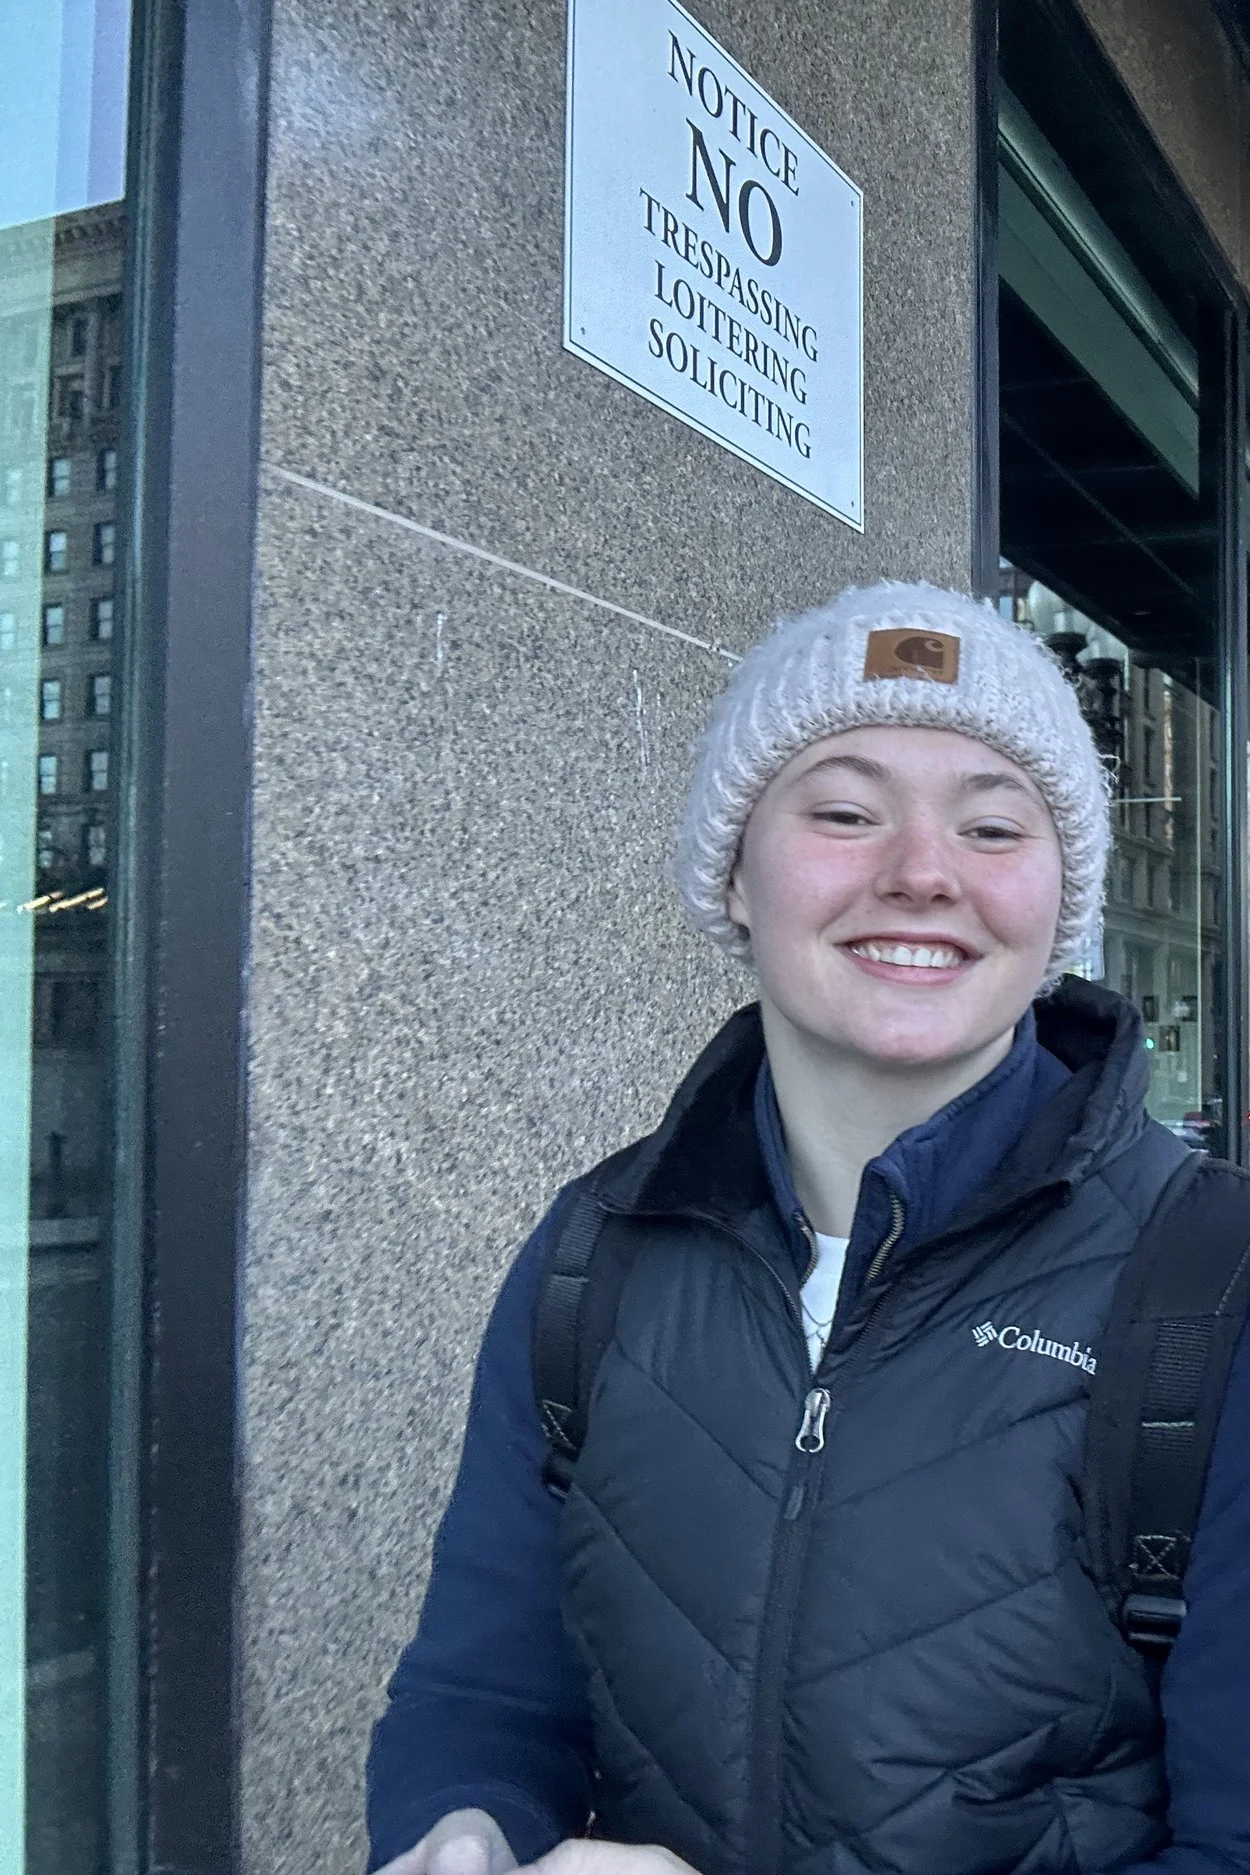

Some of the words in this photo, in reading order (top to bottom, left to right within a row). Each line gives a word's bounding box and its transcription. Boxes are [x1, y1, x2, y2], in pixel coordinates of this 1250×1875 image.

[667, 29, 799, 196] NOTICE
[685, 117, 783, 266] NO
[639, 187, 818, 362] TRESPASSING
[654, 260, 807, 405] LOITERING
[648, 318, 811, 459] SOLICITING
[999, 1326, 1097, 1375] Columbia
